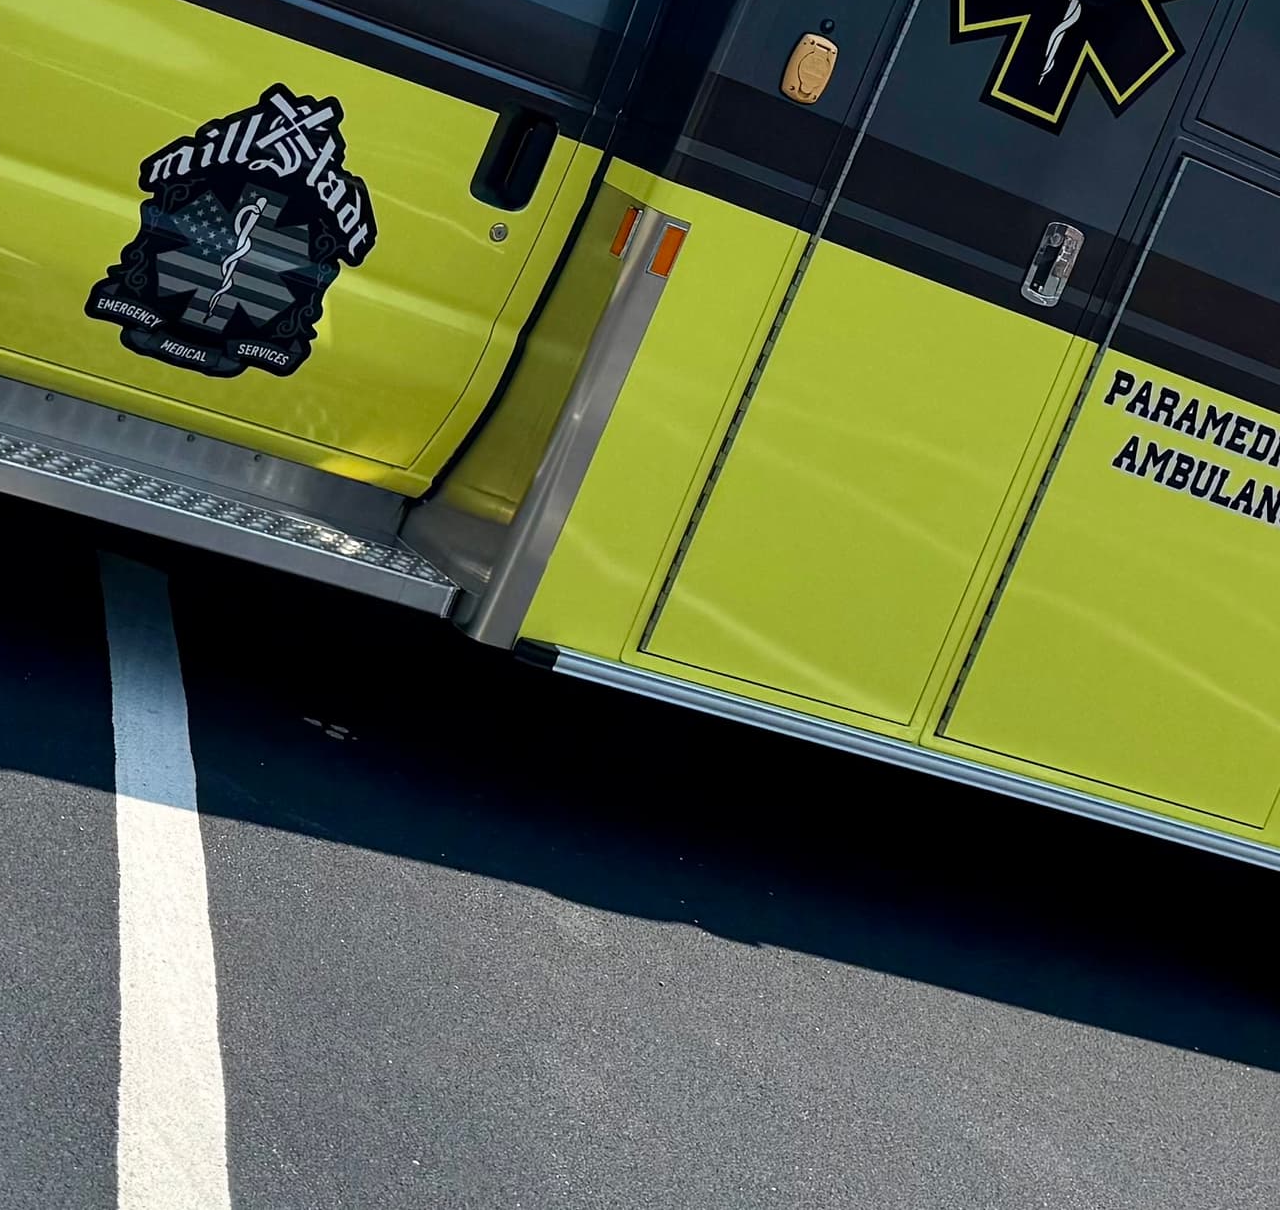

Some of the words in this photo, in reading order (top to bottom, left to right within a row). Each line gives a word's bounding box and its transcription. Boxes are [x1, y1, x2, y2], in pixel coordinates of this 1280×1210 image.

[96, 298, 162, 329] EMERGENCY
[160, 338, 207, 363] MEDICAL
[237, 343, 290, 367] SERVICES
